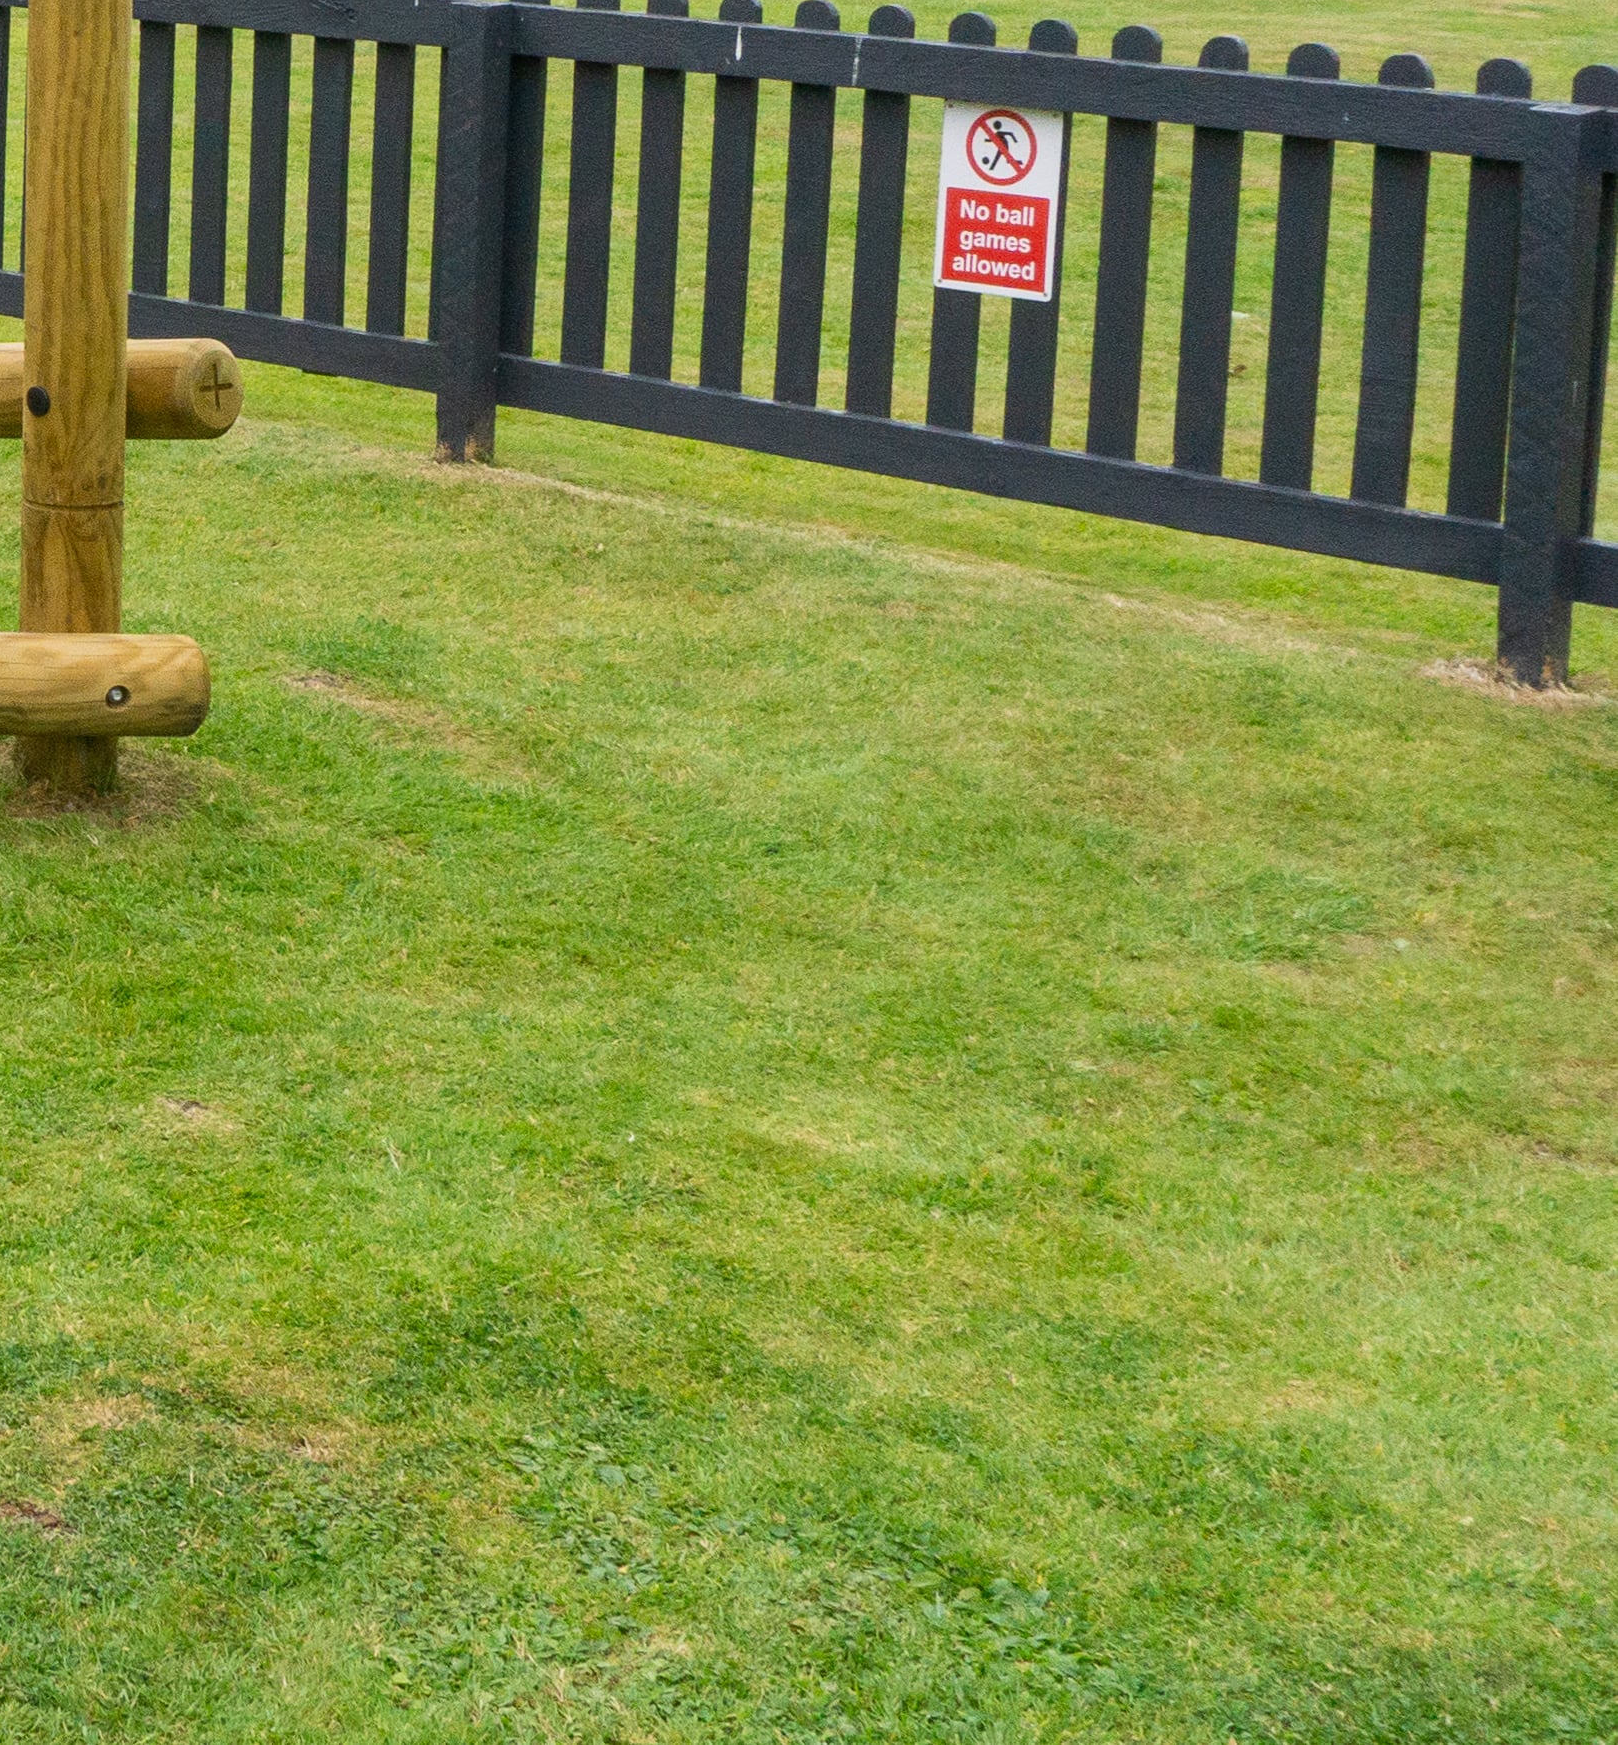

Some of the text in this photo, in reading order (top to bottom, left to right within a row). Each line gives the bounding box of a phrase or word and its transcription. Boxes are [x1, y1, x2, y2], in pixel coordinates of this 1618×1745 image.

[959, 198, 1035, 227] No ball
[959, 230, 1031, 253] games
[952, 254, 1035, 281] allowed
